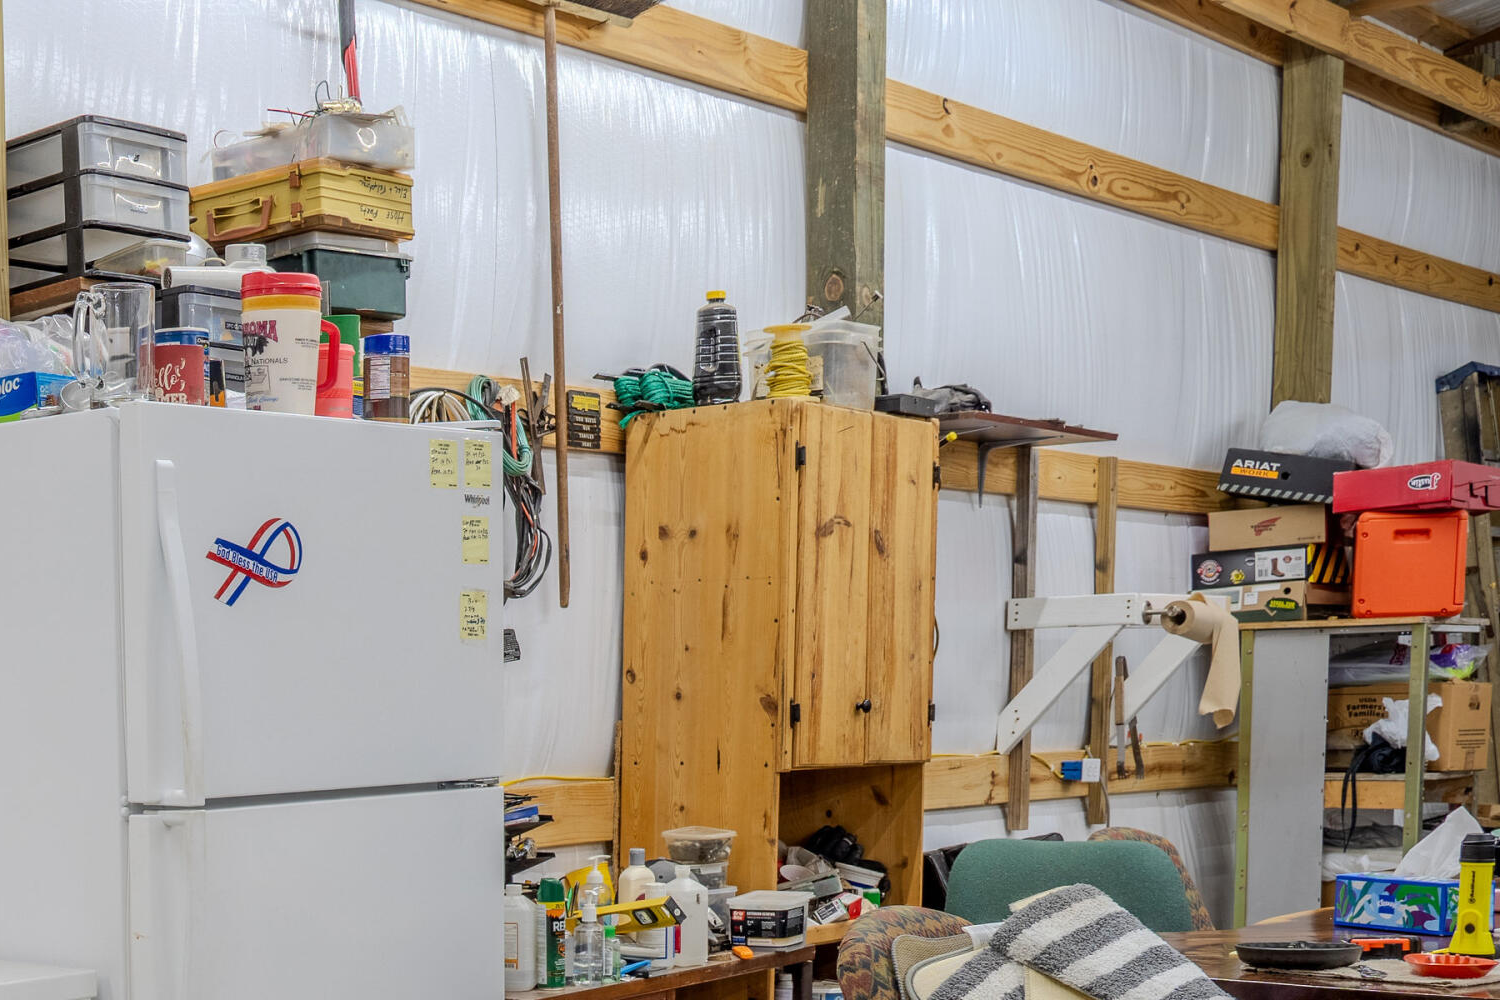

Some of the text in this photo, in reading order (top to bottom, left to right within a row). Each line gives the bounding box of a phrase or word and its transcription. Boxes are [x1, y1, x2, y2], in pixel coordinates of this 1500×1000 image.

[243, 320, 278, 343] HOMA
[1232, 459, 1281, 471] ARIAT
[1240, 468, 1269, 477] WORK
[216, 544, 279, 582] God Bless the USA
